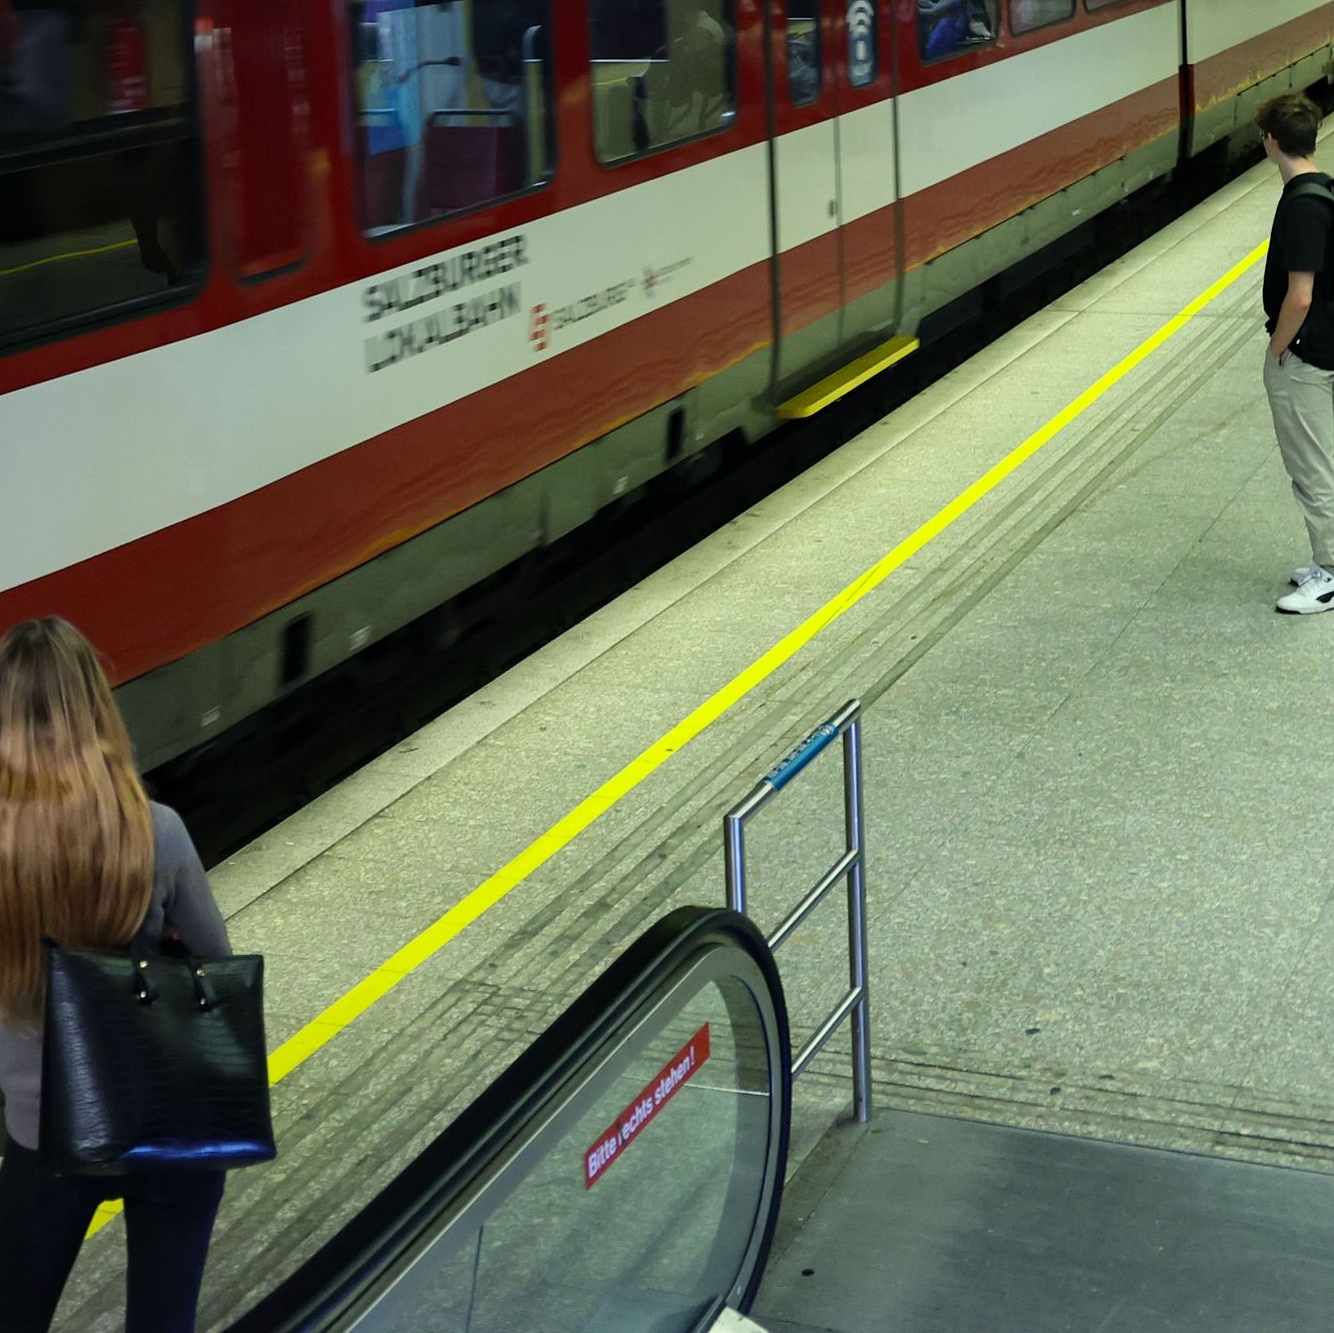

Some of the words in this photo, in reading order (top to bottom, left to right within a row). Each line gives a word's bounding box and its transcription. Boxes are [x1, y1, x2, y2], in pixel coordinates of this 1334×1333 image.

[362, 234, 530, 325] SALZBURGER
[587, 1134, 617, 1179] Bitte
[617, 1096, 655, 1147] rechts
